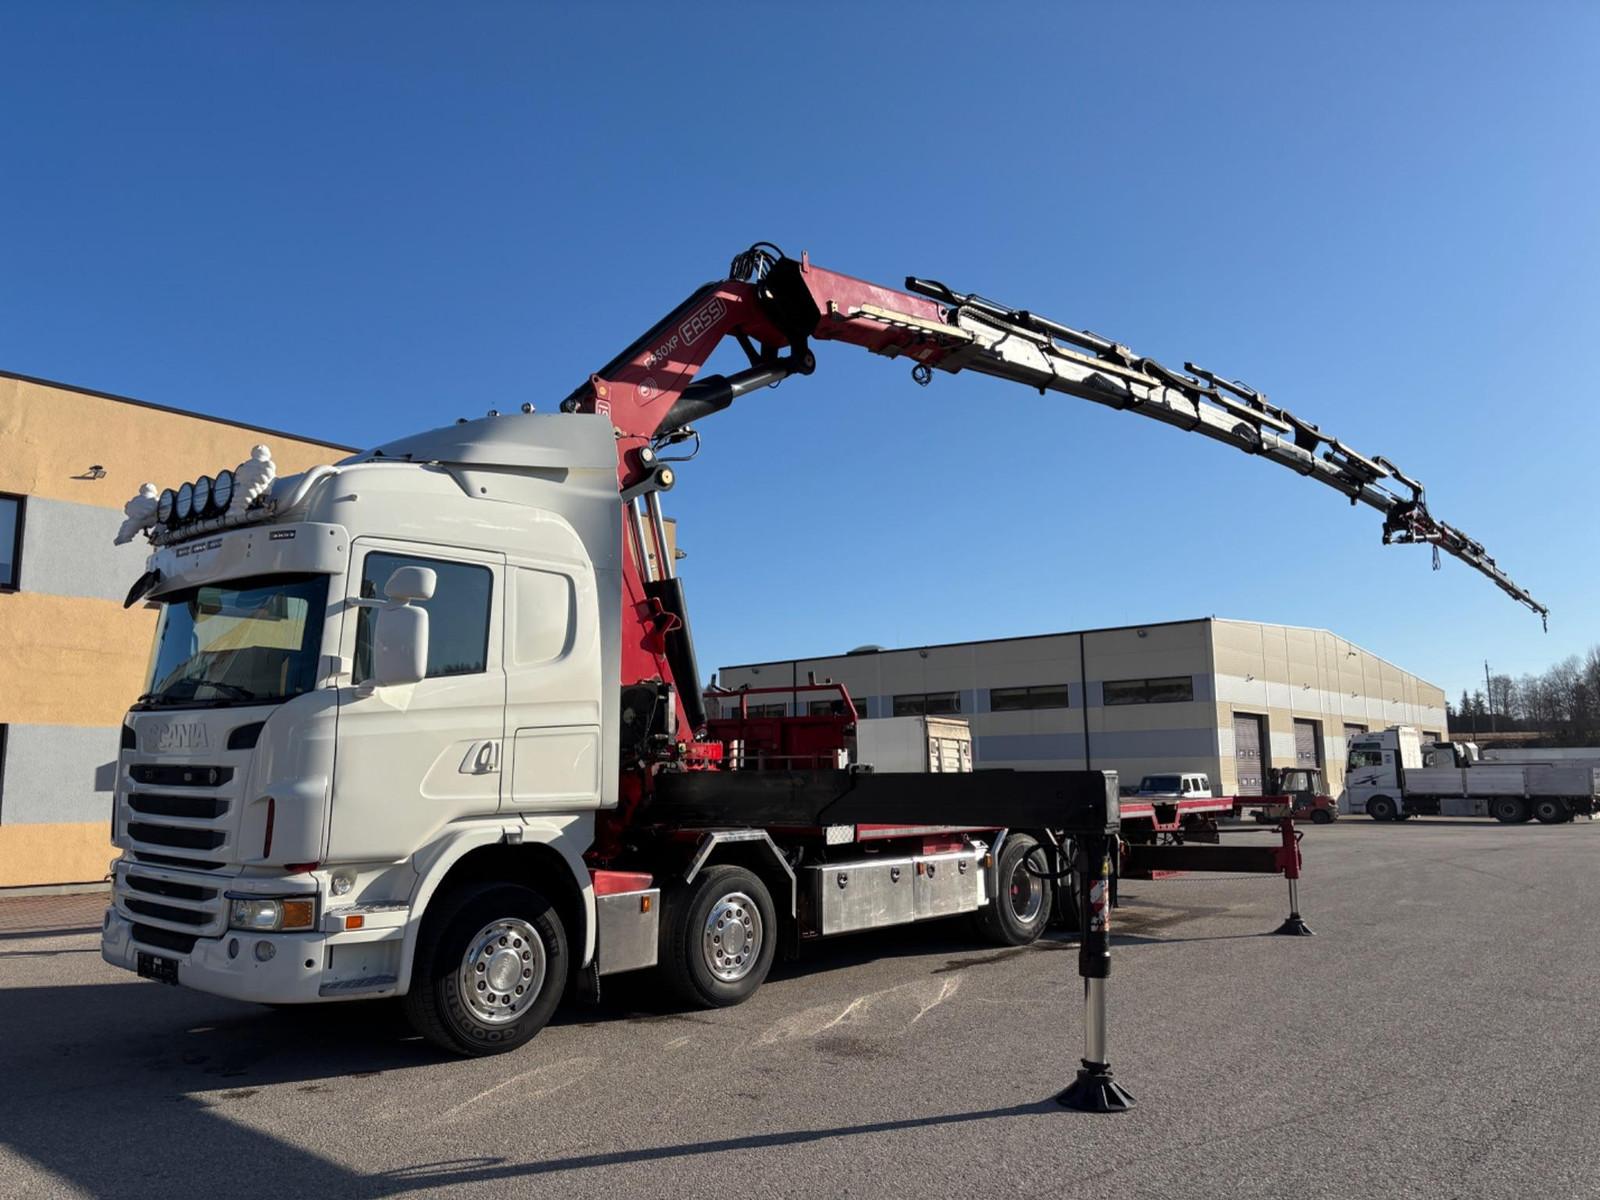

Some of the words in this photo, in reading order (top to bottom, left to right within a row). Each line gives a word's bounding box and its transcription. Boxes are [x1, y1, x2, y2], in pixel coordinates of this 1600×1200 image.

[682, 298, 725, 342] FASSI
[149, 721, 209, 749] SCANIA
[446, 971, 517, 1041] GOODRID
